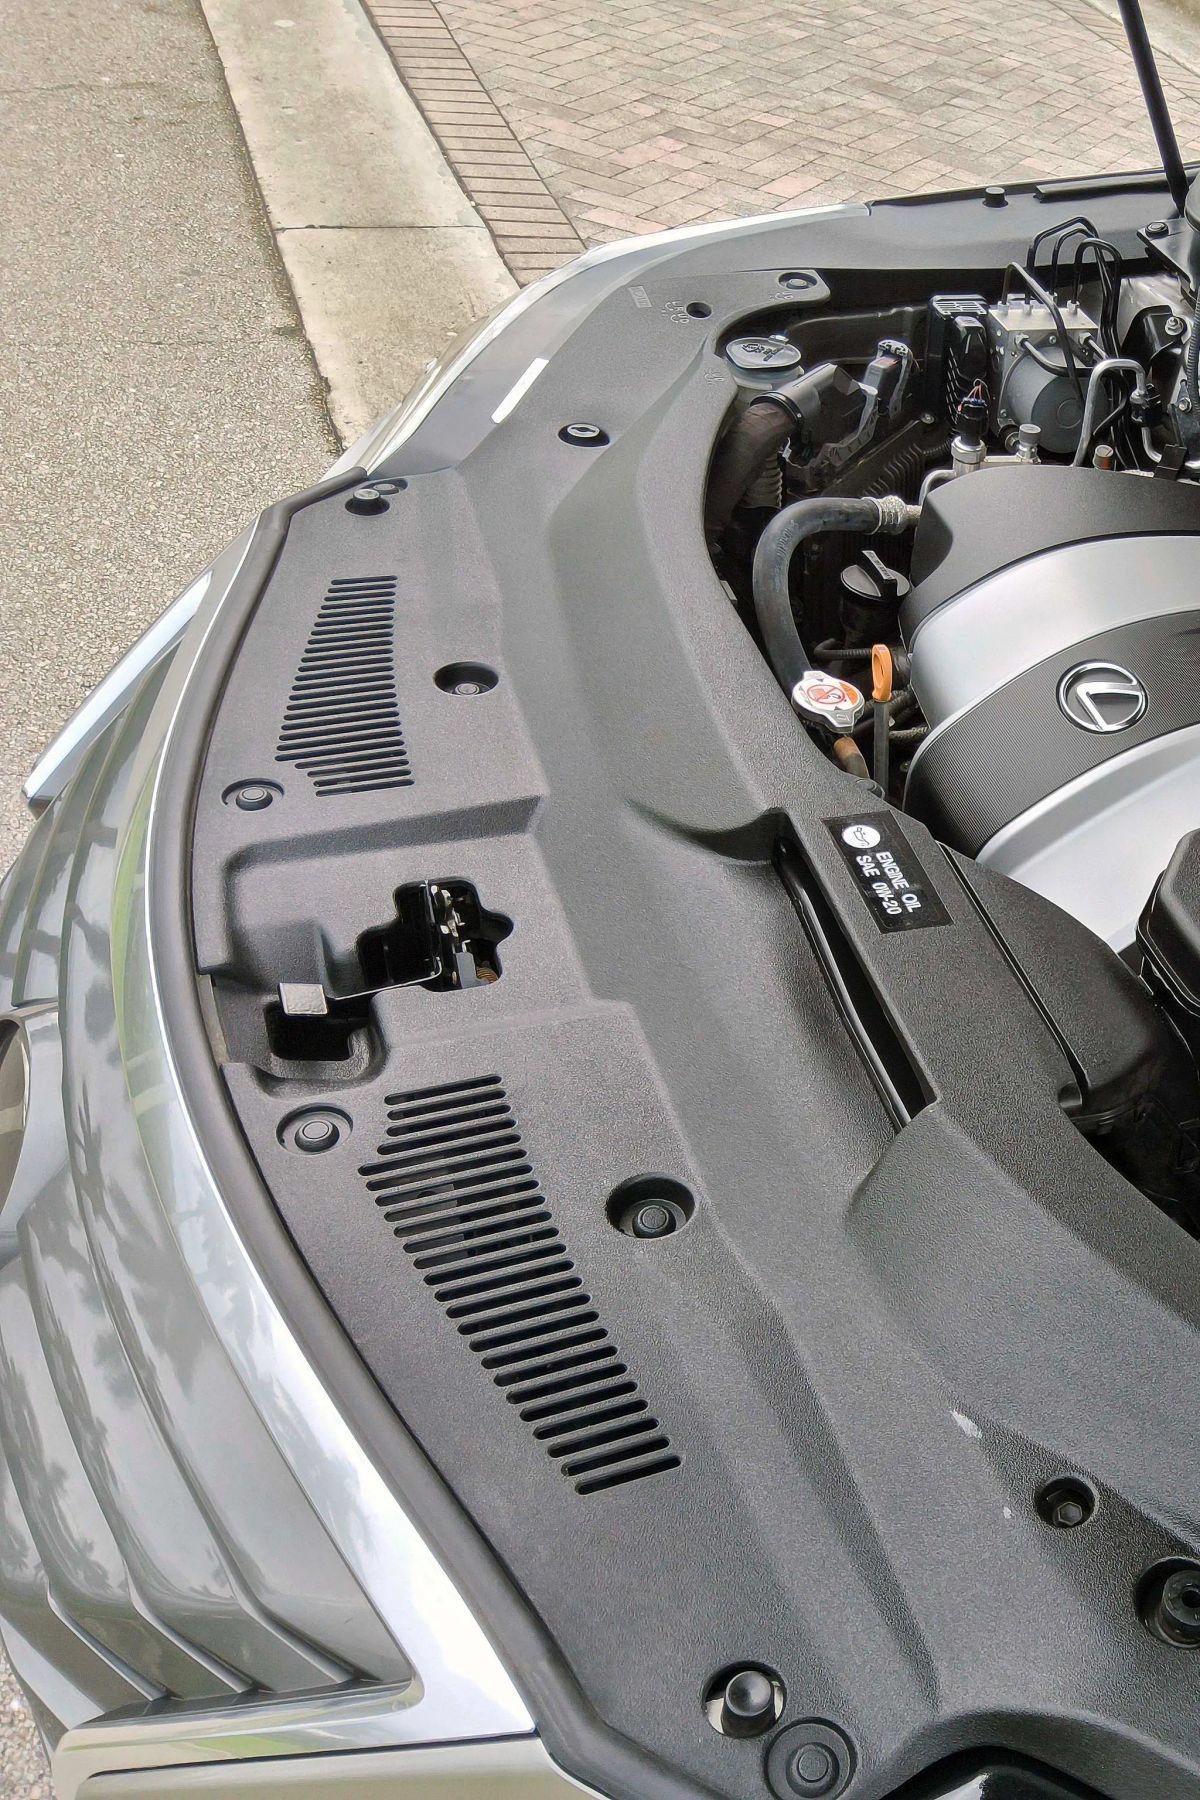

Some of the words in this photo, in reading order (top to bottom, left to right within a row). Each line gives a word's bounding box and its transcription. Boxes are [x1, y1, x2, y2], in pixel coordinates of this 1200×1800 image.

[856, 855, 880, 877] SAE
[872, 881, 902, 915] 0W-20
[876, 851, 910, 890] ENGINE
[901, 893, 922, 913] OIL
